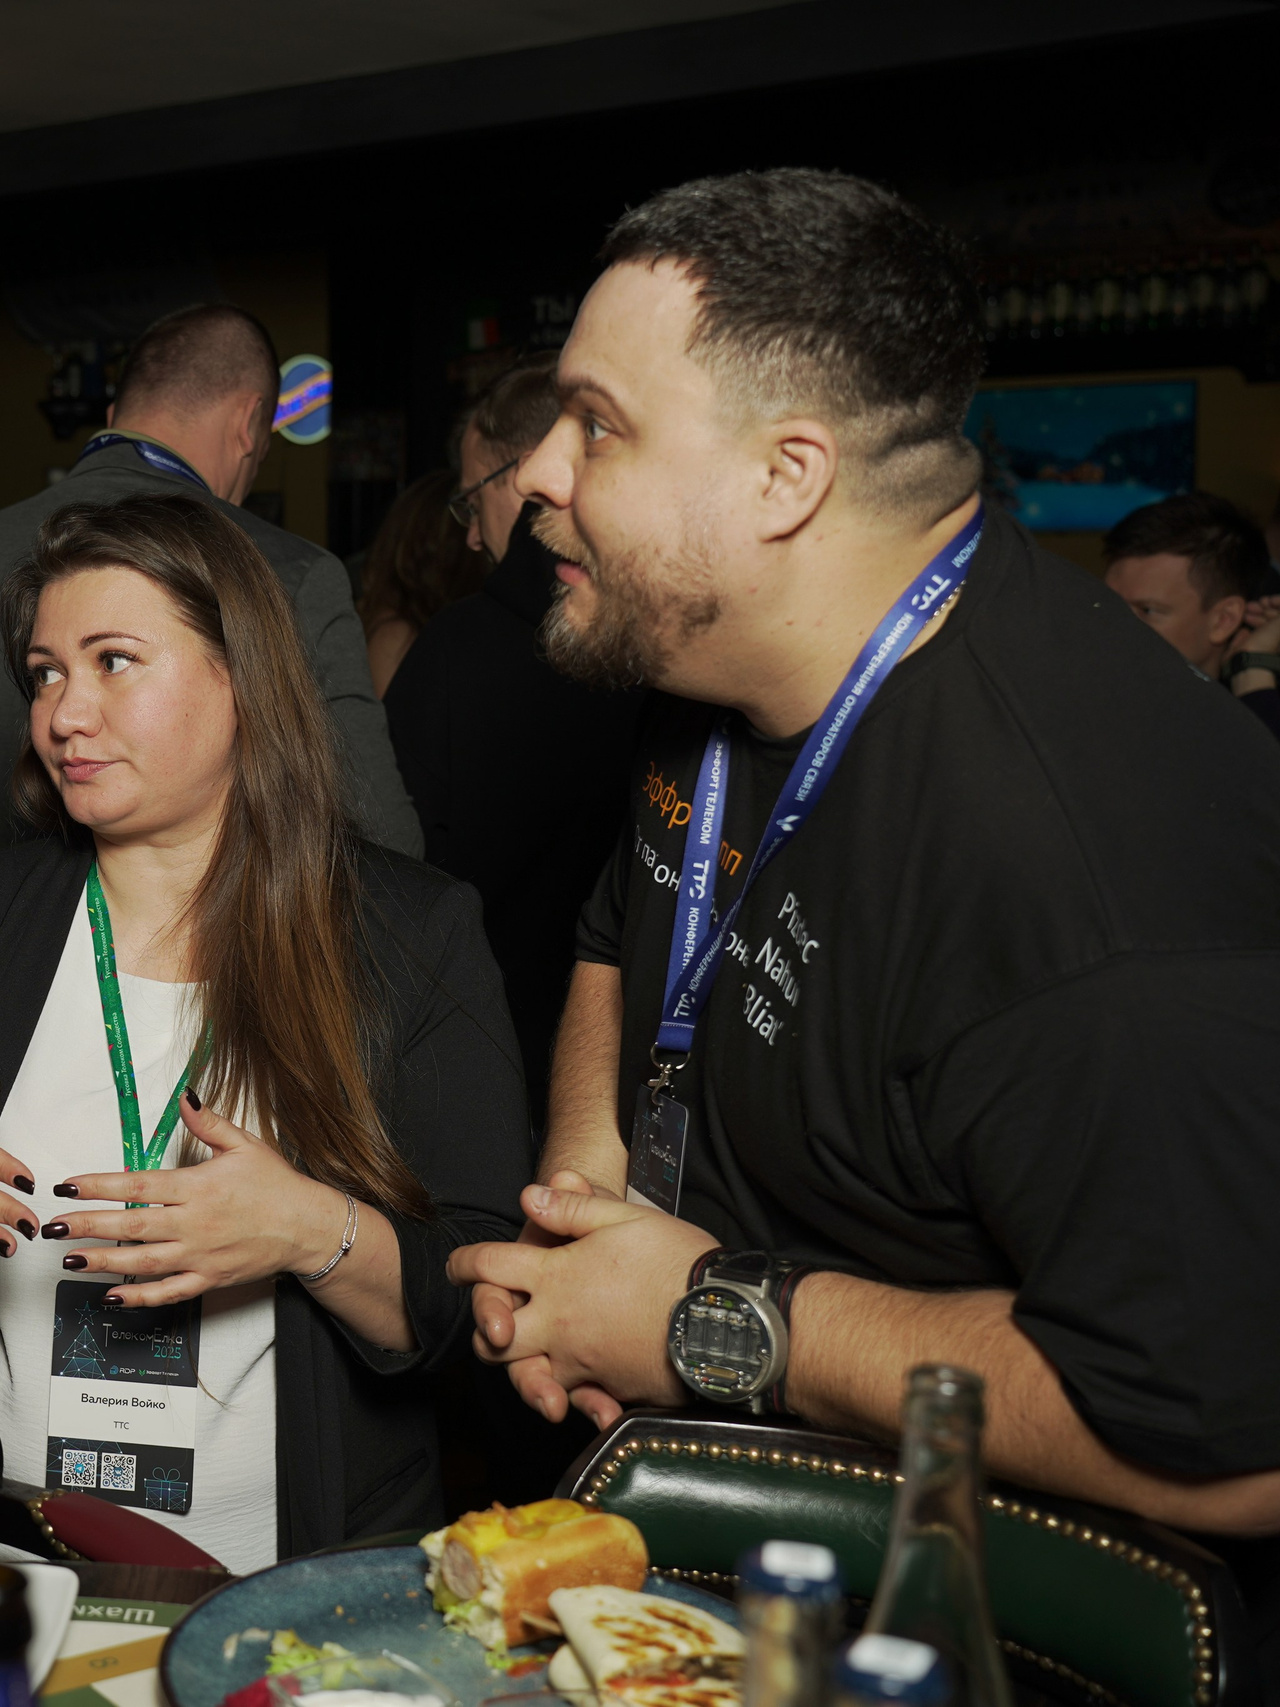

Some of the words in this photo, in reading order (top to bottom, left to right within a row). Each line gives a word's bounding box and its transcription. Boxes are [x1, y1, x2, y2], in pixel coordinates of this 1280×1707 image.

[911, 574, 952, 611] ТТС
[851, 612, 915, 697] КОНФЕРЕНЦИЯ
[812, 694, 858, 768] ОПЕРАТОРОВ
[710, 741, 724, 790] ЭФФОРТ
[794, 767, 820, 802] СВЯЗИ
[699, 791, 718, 845] ТЕЛЕКОМ
[688, 859, 711, 900] ТТС
[94, 897, 106, 932] Сообщества
[100, 931, 109, 958] Телеком
[104, 958, 112, 979] Тусовка
[673, 992, 697, 1018] ТТС
[111, 1012, 123, 1049] Сообщества
[119, 1049, 128, 1075] Телеком
[123, 1075, 132, 1097] Тусовка
[132, 1132, 140, 1172] Сообщества
[151, 1132, 166, 1158] Тусовка
[153, 1345, 182, 1360] 2025
[81, 1393, 129, 1407] Валерия
[131, 1398, 166, 1410] Войко
